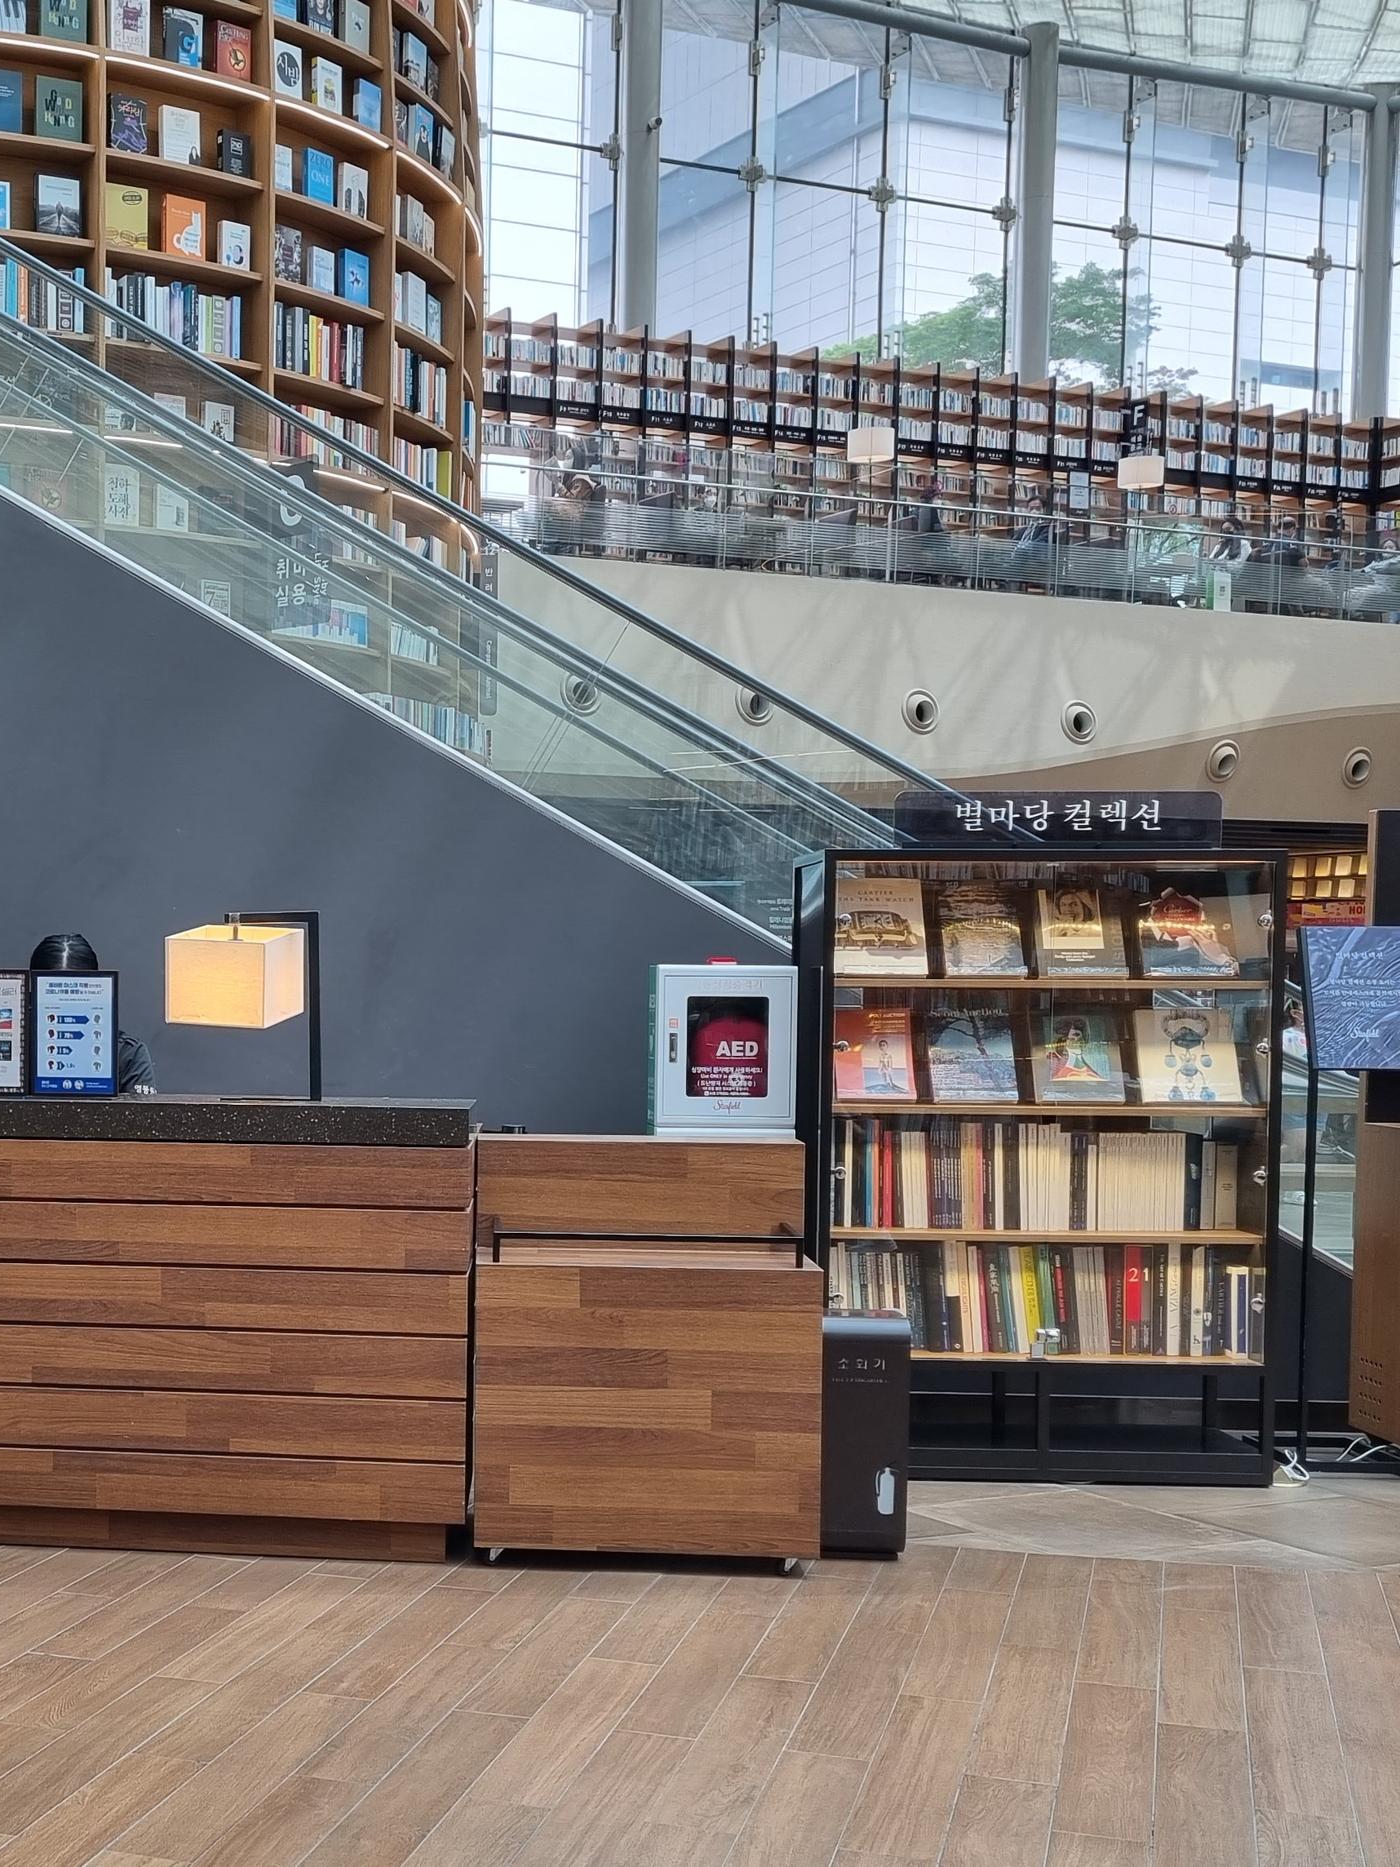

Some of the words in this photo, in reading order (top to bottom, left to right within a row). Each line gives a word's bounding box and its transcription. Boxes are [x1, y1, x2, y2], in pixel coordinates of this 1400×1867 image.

[277, 54, 300, 88] 시밤
[1133, 404, 1145, 426] F
[276, 583, 307, 608] 실용
[955, 799, 1055, 832] 별마당
[1063, 798, 1162, 832] 컬렉션
[715, 1040, 759, 1057] AED
[1127, 1267, 1140, 1283] 2
[1142, 1267, 1150, 1282] 1
[837, 1357, 886, 1371] 소화기
